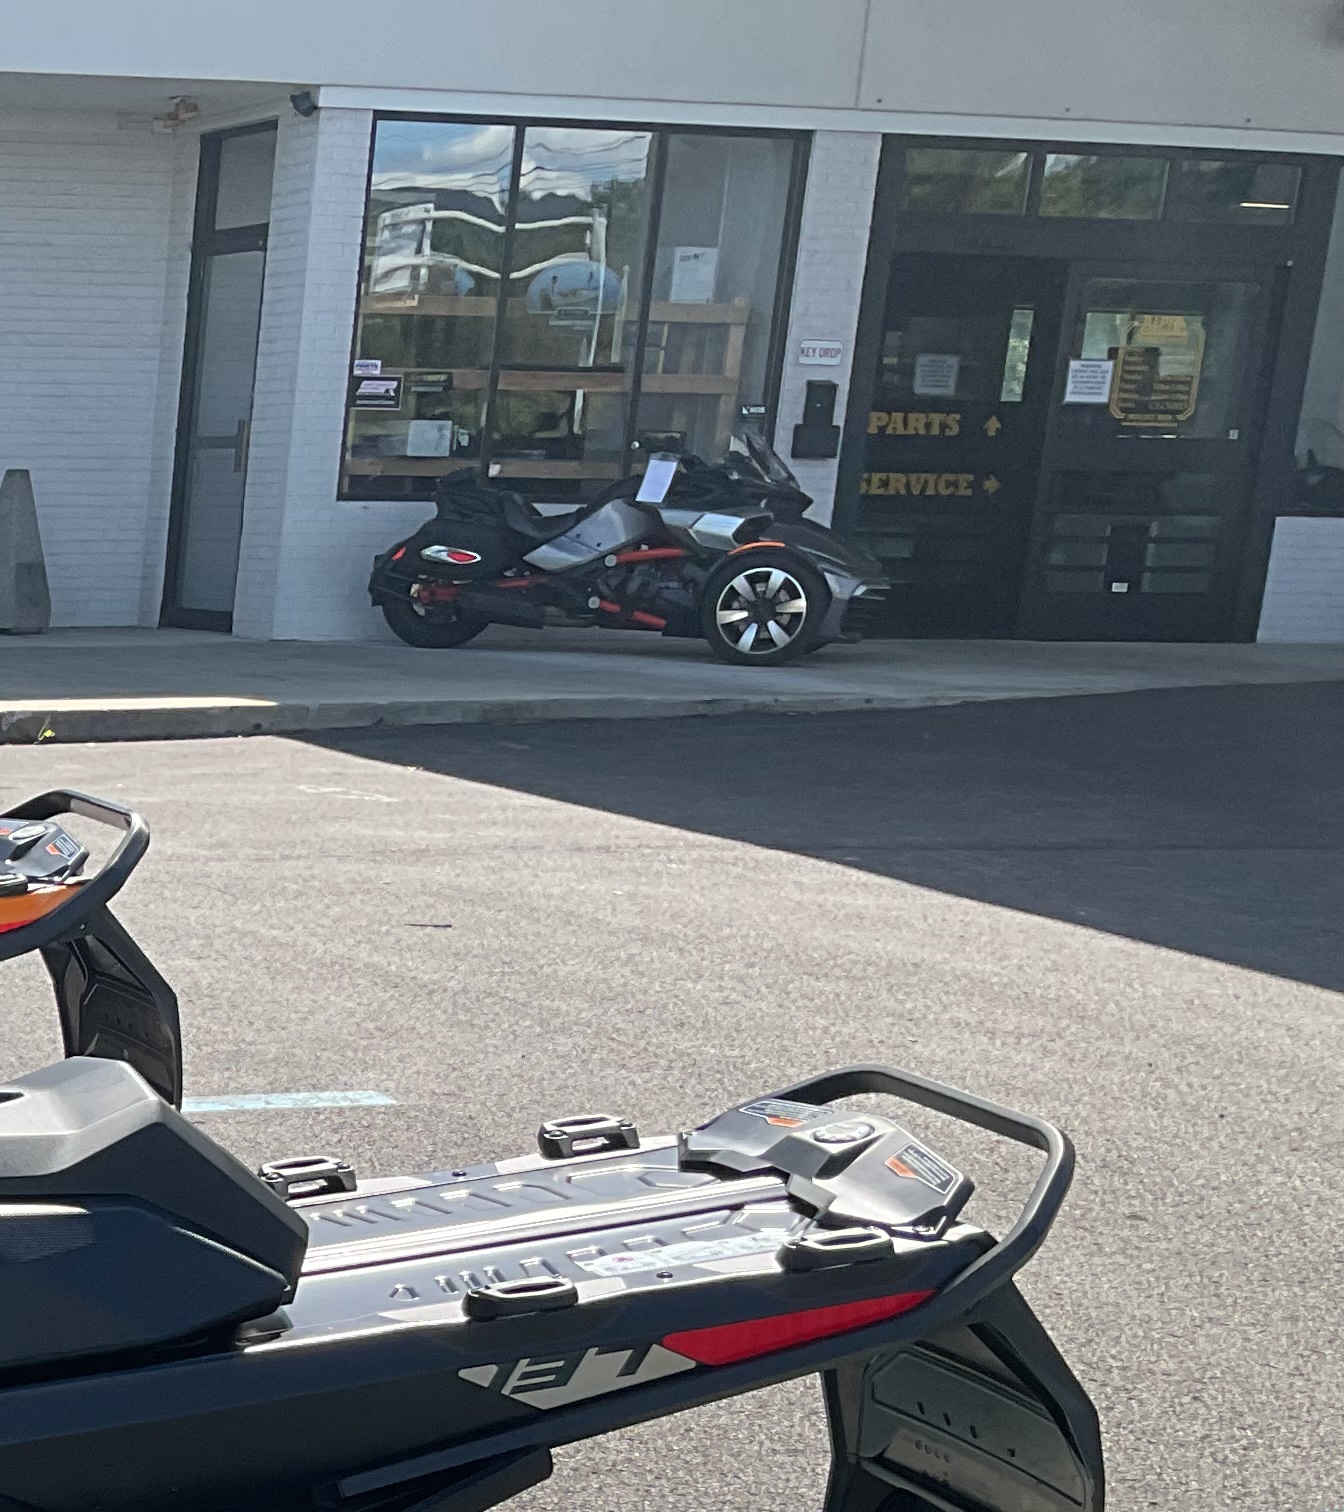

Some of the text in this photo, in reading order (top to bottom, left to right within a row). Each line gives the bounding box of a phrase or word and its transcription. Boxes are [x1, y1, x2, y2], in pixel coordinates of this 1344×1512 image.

[801, 346, 842, 358] KEY DROP
[866, 411, 961, 436] PARTS
